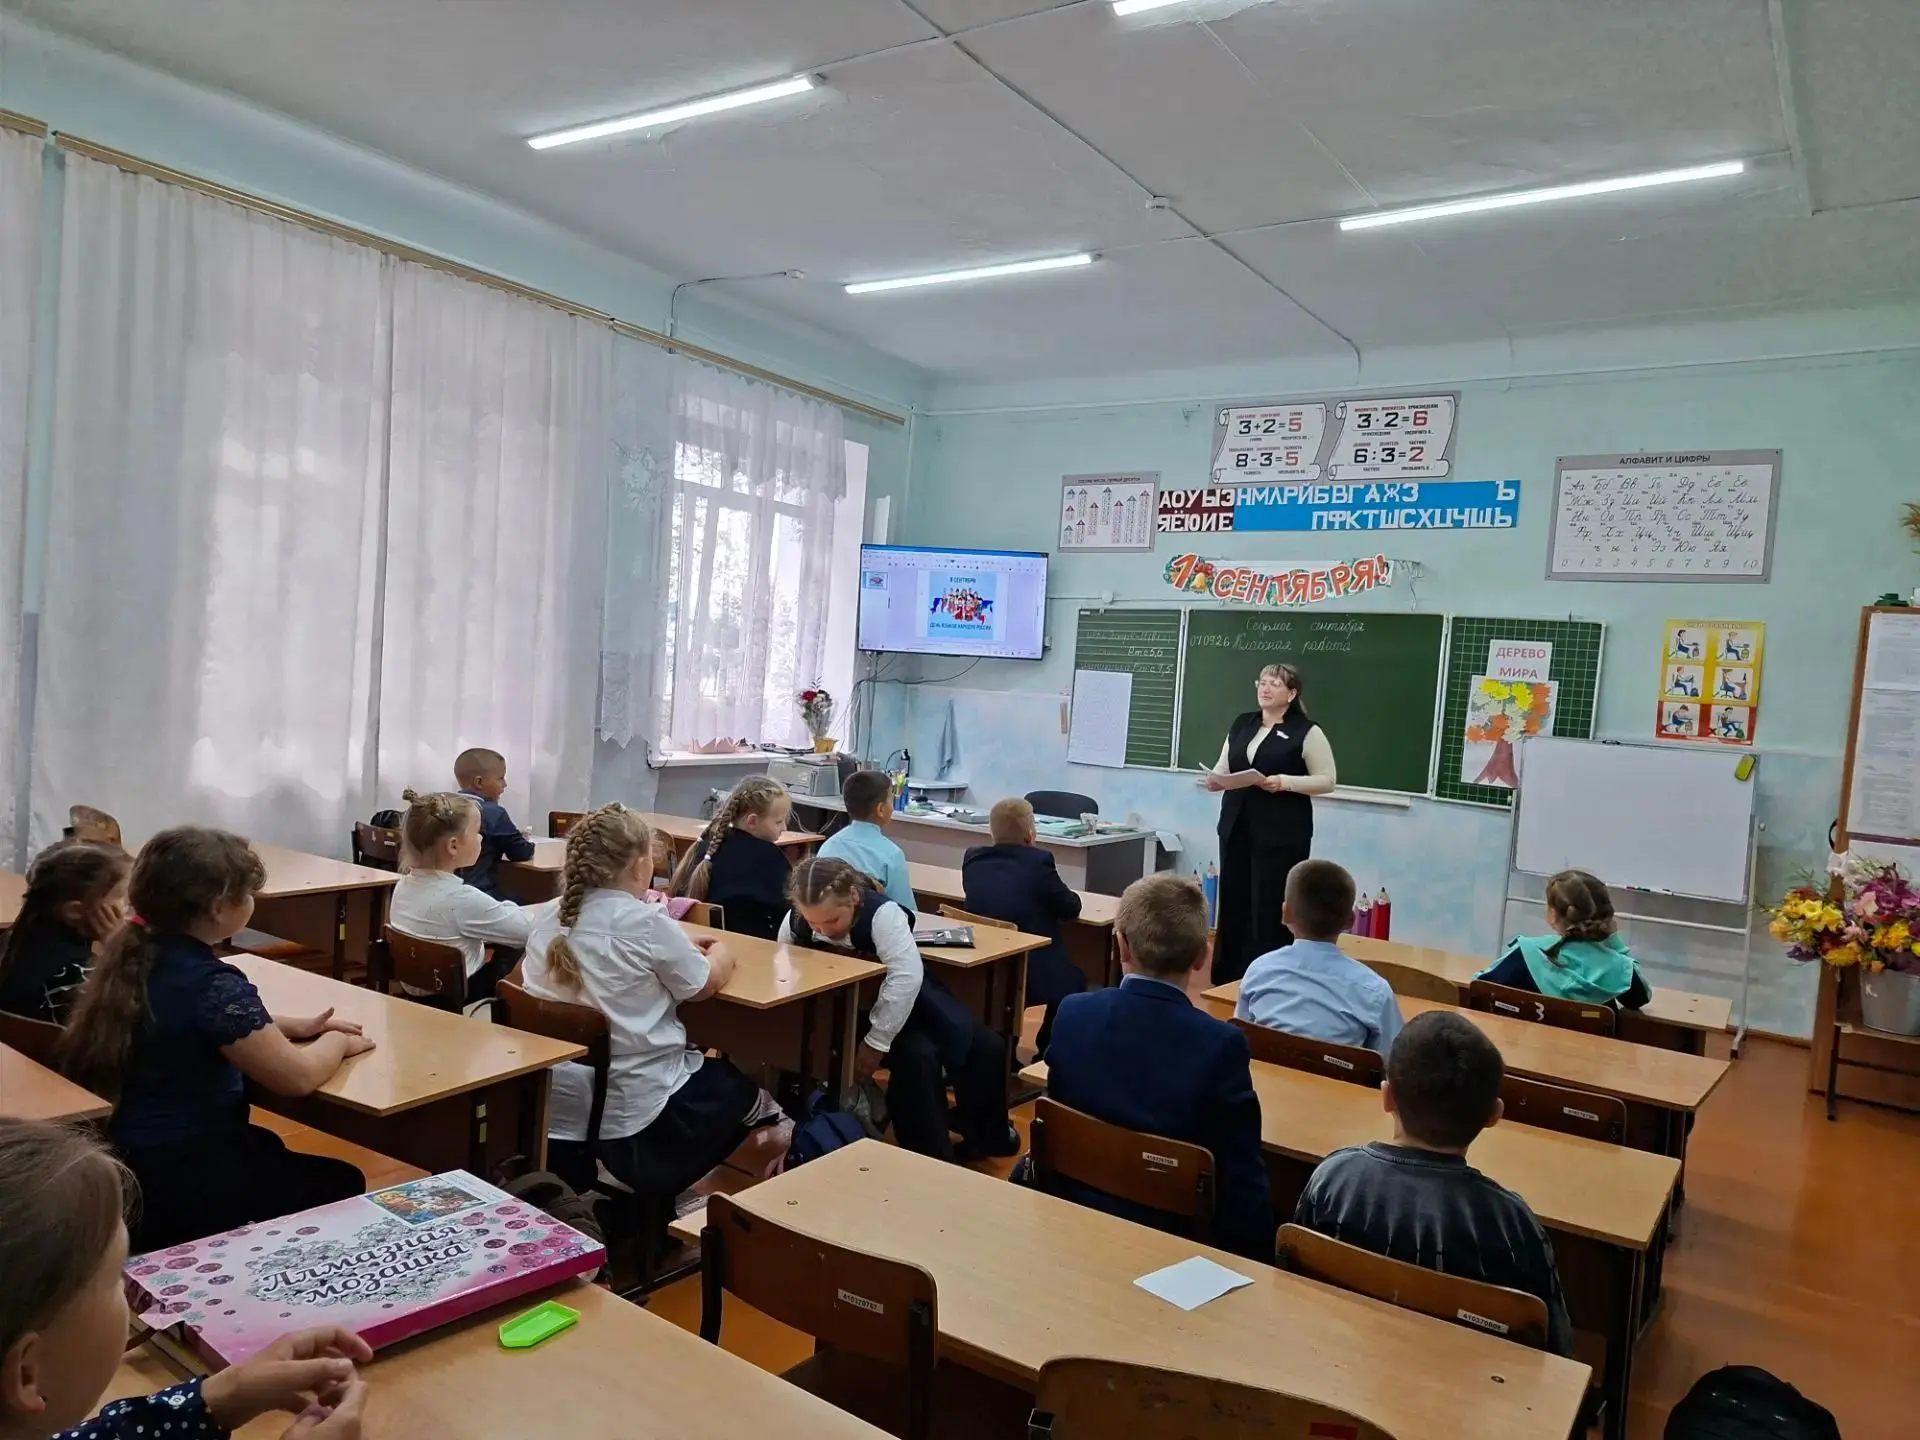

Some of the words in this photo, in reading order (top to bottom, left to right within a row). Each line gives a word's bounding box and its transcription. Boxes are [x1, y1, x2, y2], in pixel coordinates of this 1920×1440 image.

[1620, 457, 1664, 465] АЛФАВИТ
[1675, 455, 1711, 464] ЦИФРЫ
[1171, 552, 1200, 590] 1
[1212, 553, 1389, 606] СЕНТЯБРЯ!
[1496, 647, 1546, 659] ДЕРЕВО
[1500, 668, 1538, 679] МИРА
[263, 1225, 464, 1292] Алмазная
[305, 1243, 470, 1304] мозаика
